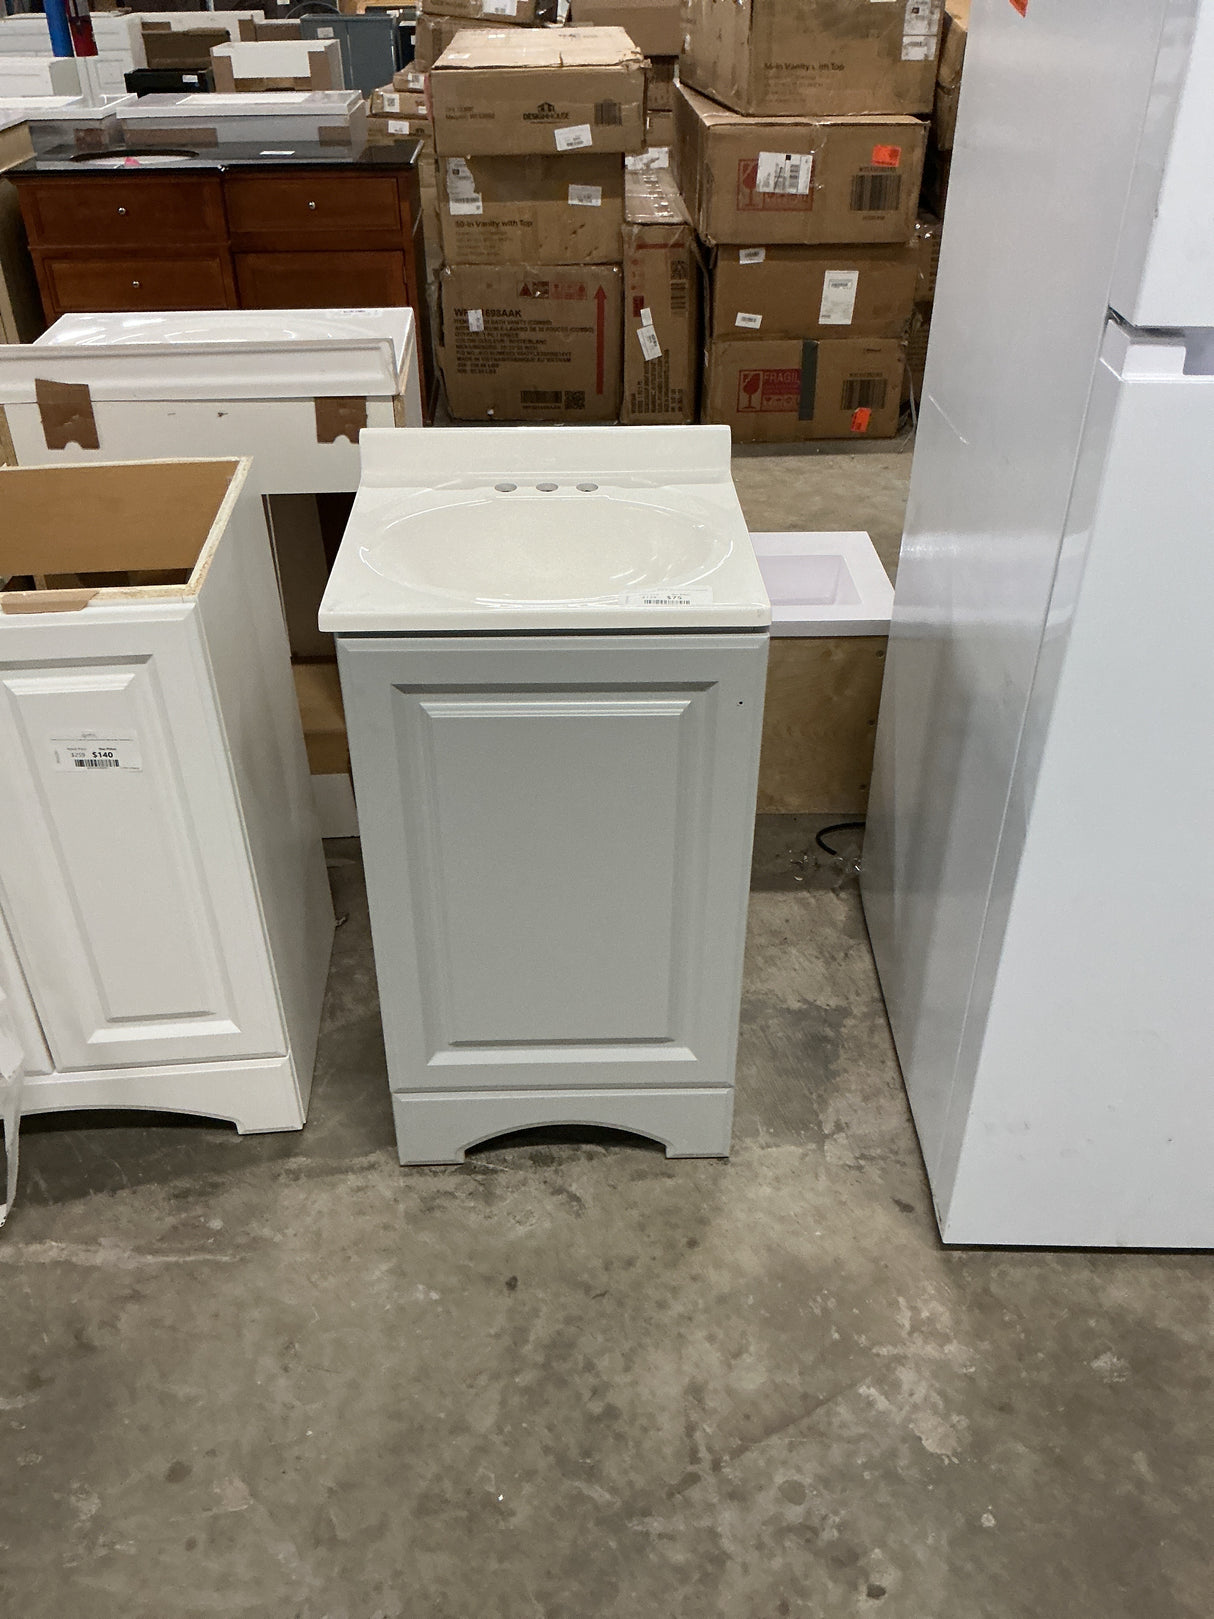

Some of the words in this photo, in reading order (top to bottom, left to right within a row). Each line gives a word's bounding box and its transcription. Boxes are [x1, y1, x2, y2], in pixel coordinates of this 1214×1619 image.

[831, 62, 845, 71] Top
[475, 220, 500, 229] Vanity
[519, 219, 533, 228] Top
[763, 371, 800, 383] FRAGIL
[91, 751, 114, 759] $140
